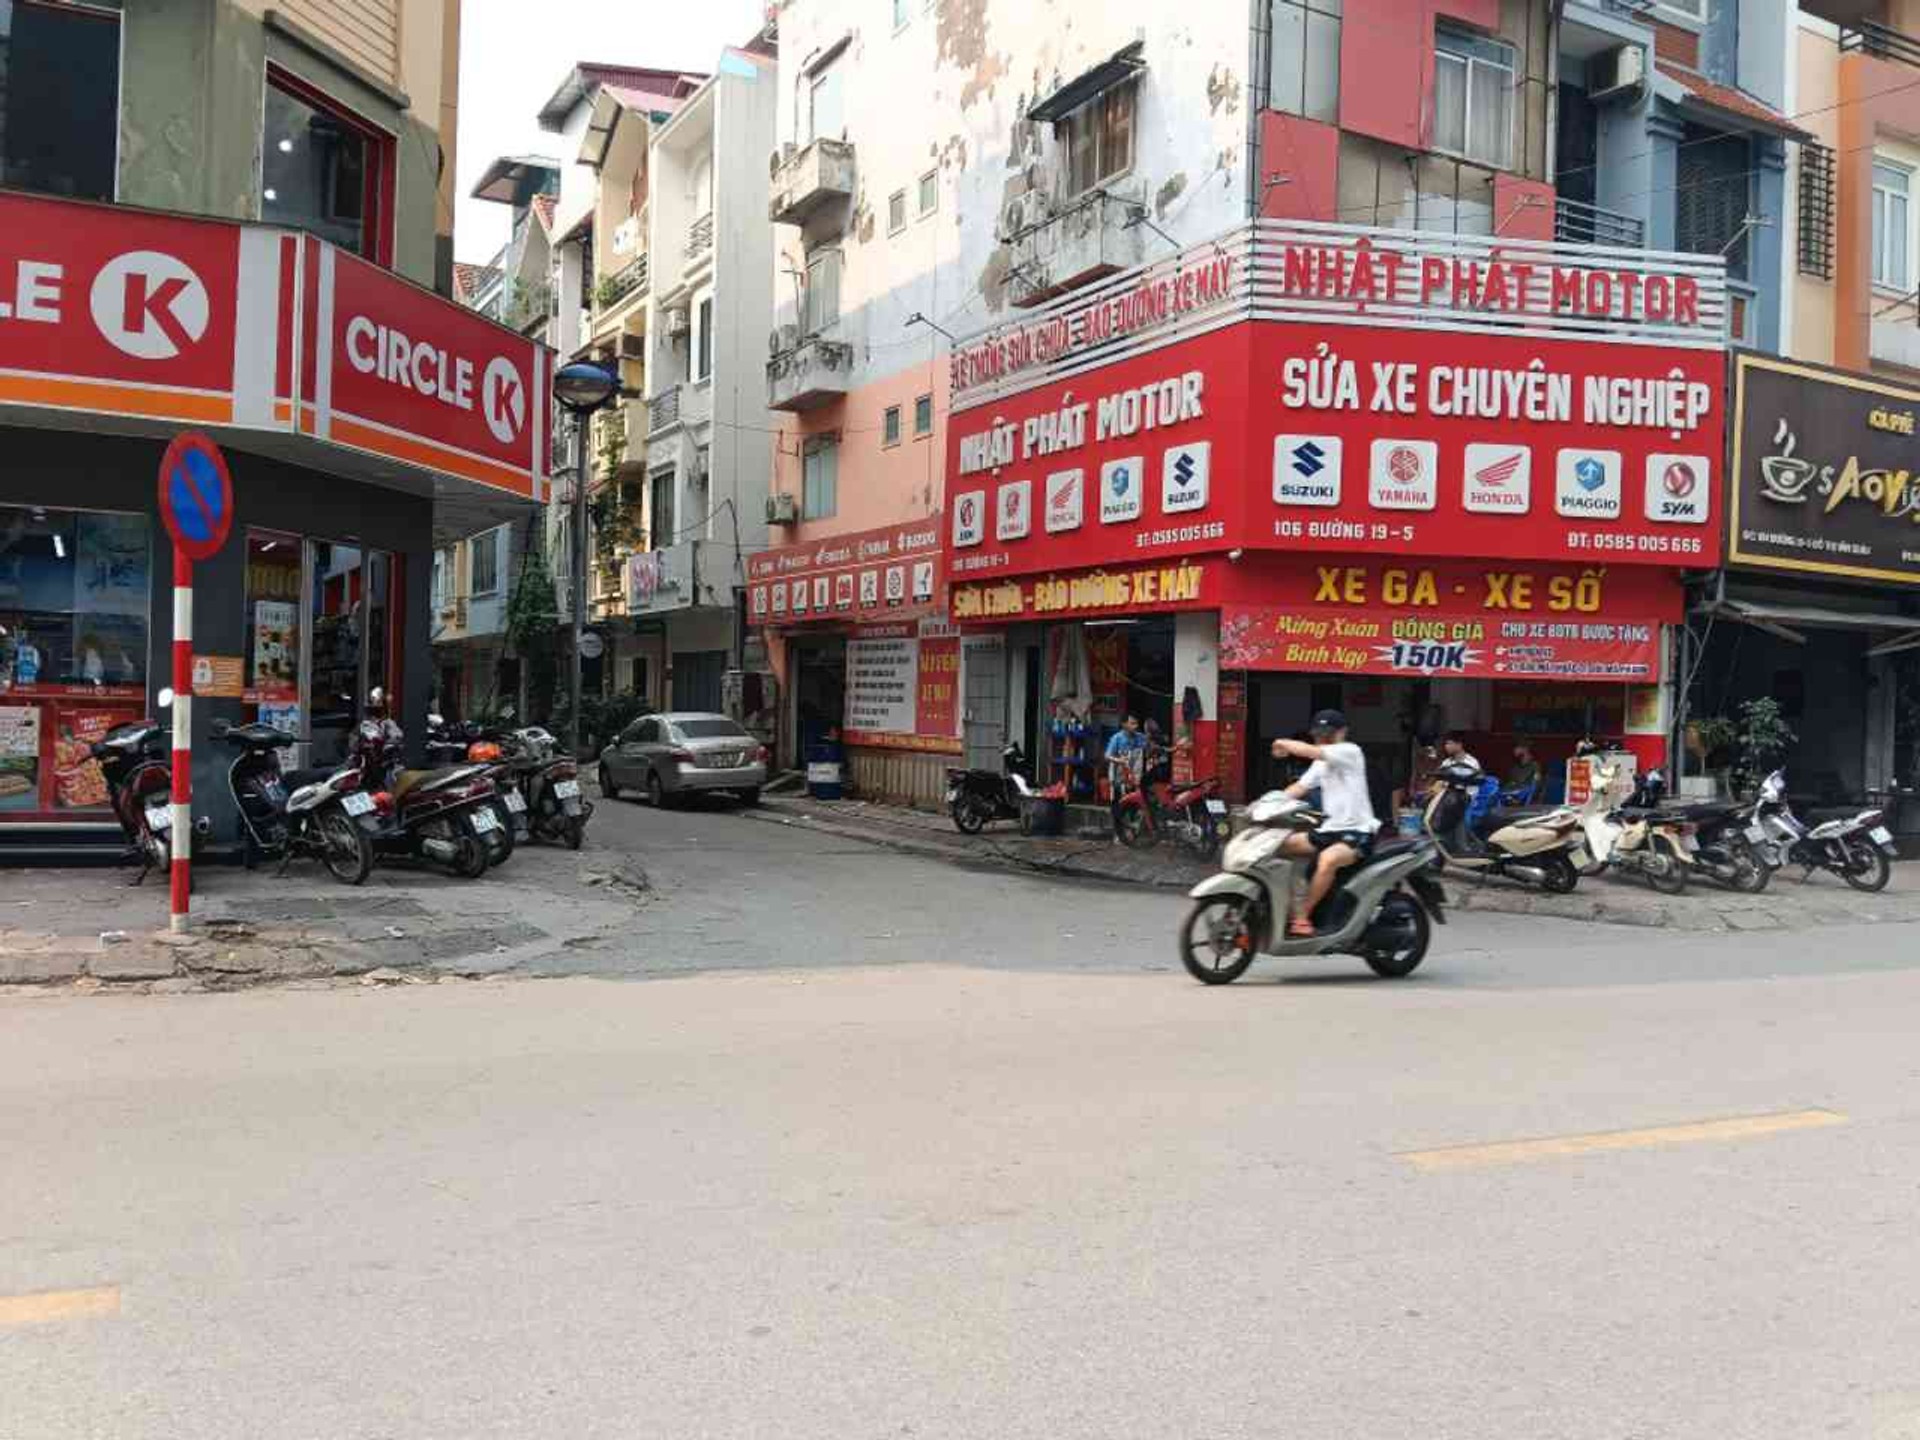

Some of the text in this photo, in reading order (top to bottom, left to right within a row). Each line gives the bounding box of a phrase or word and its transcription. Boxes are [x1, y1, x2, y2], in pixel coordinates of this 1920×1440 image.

[1284, 237, 1699, 325] NHẬT PHÁT MOTOR
[0, 259, 202, 355] E K
[346, 315, 524, 441] CIRCLE K
[1282, 342, 1711, 439] SỬA XE CHUYÊN NGHIỆP
[960, 371, 1205, 476] NHẬT PHÁT MOTOR
[1281, 485, 1334, 498] SUZUKI
[1378, 488, 1428, 504] YAMAHA
[1471, 492, 1524, 506] HONDA
[1561, 497, 1617, 511] PIAGGIO
[1661, 501, 1695, 516] SYM
[1274, 520, 1303, 536] 106
[1308, 519, 1365, 539] ĐƯỜNG
[1594, 533, 1636, 551] 0585
[1638, 534, 1668, 552] 005
[1671, 536, 1701, 554] 666
[1130, 570, 1158, 604] XE
[1160, 559, 1204, 601] MÁY
[1315, 566, 1367, 603] XE
[1382, 569, 1439, 606] GA
[1483, 573, 1533, 610] XE
[1548, 568, 1607, 612] SỐ
[1330, 616, 1380, 638] Xuân
[1392, 644, 1467, 670] 150K
